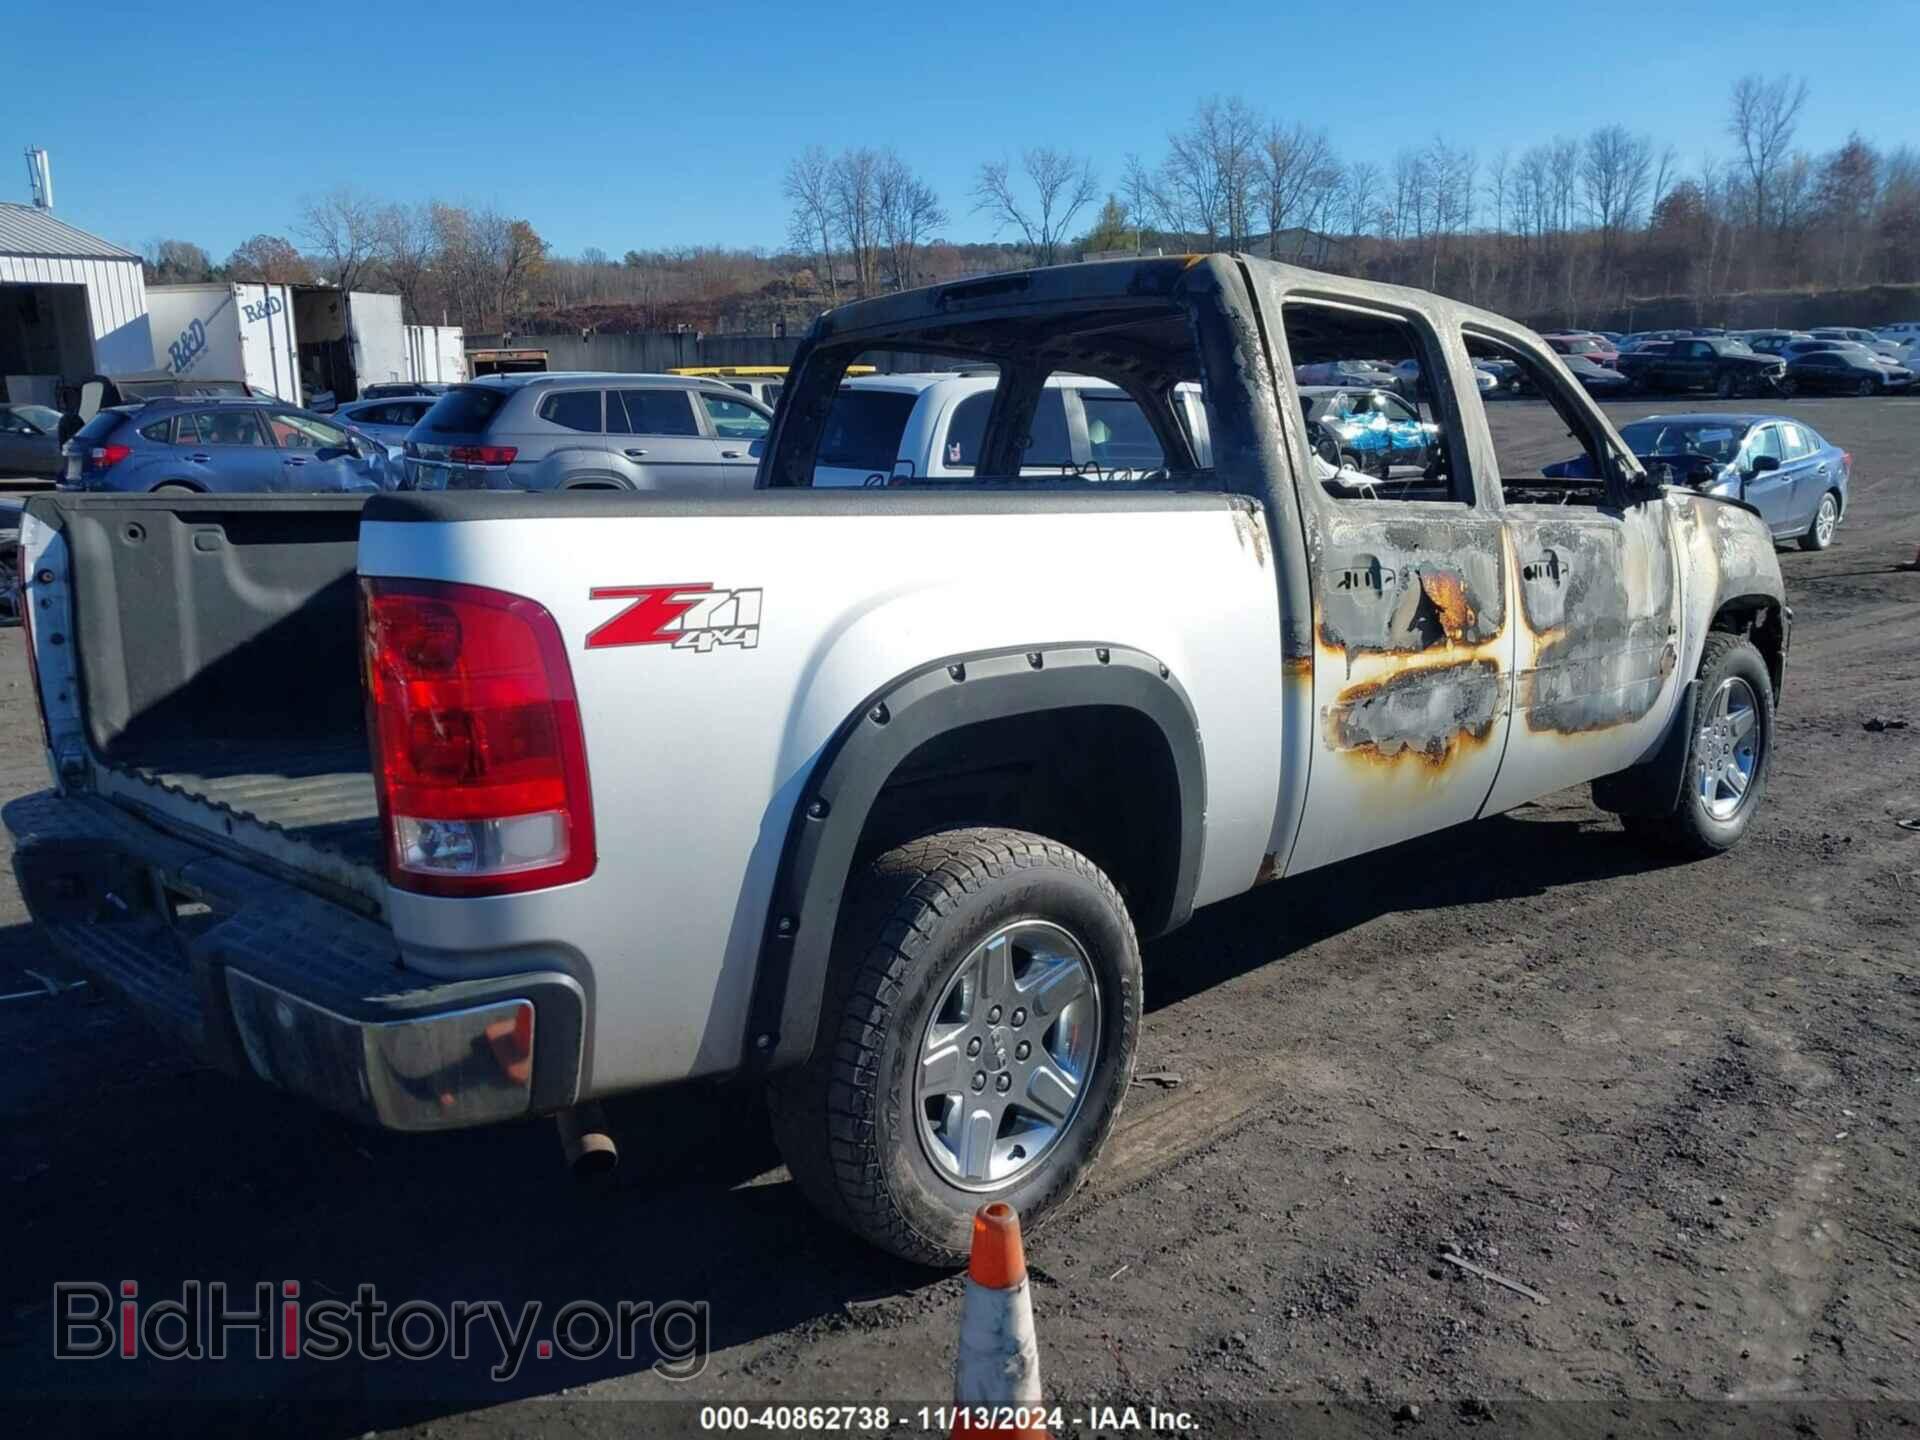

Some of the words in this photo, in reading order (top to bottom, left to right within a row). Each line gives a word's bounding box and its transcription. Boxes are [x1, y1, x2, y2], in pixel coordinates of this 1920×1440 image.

[242, 296, 282, 323] R&D
[168, 318, 205, 373] R&D
[584, 582, 763, 650] Z71
